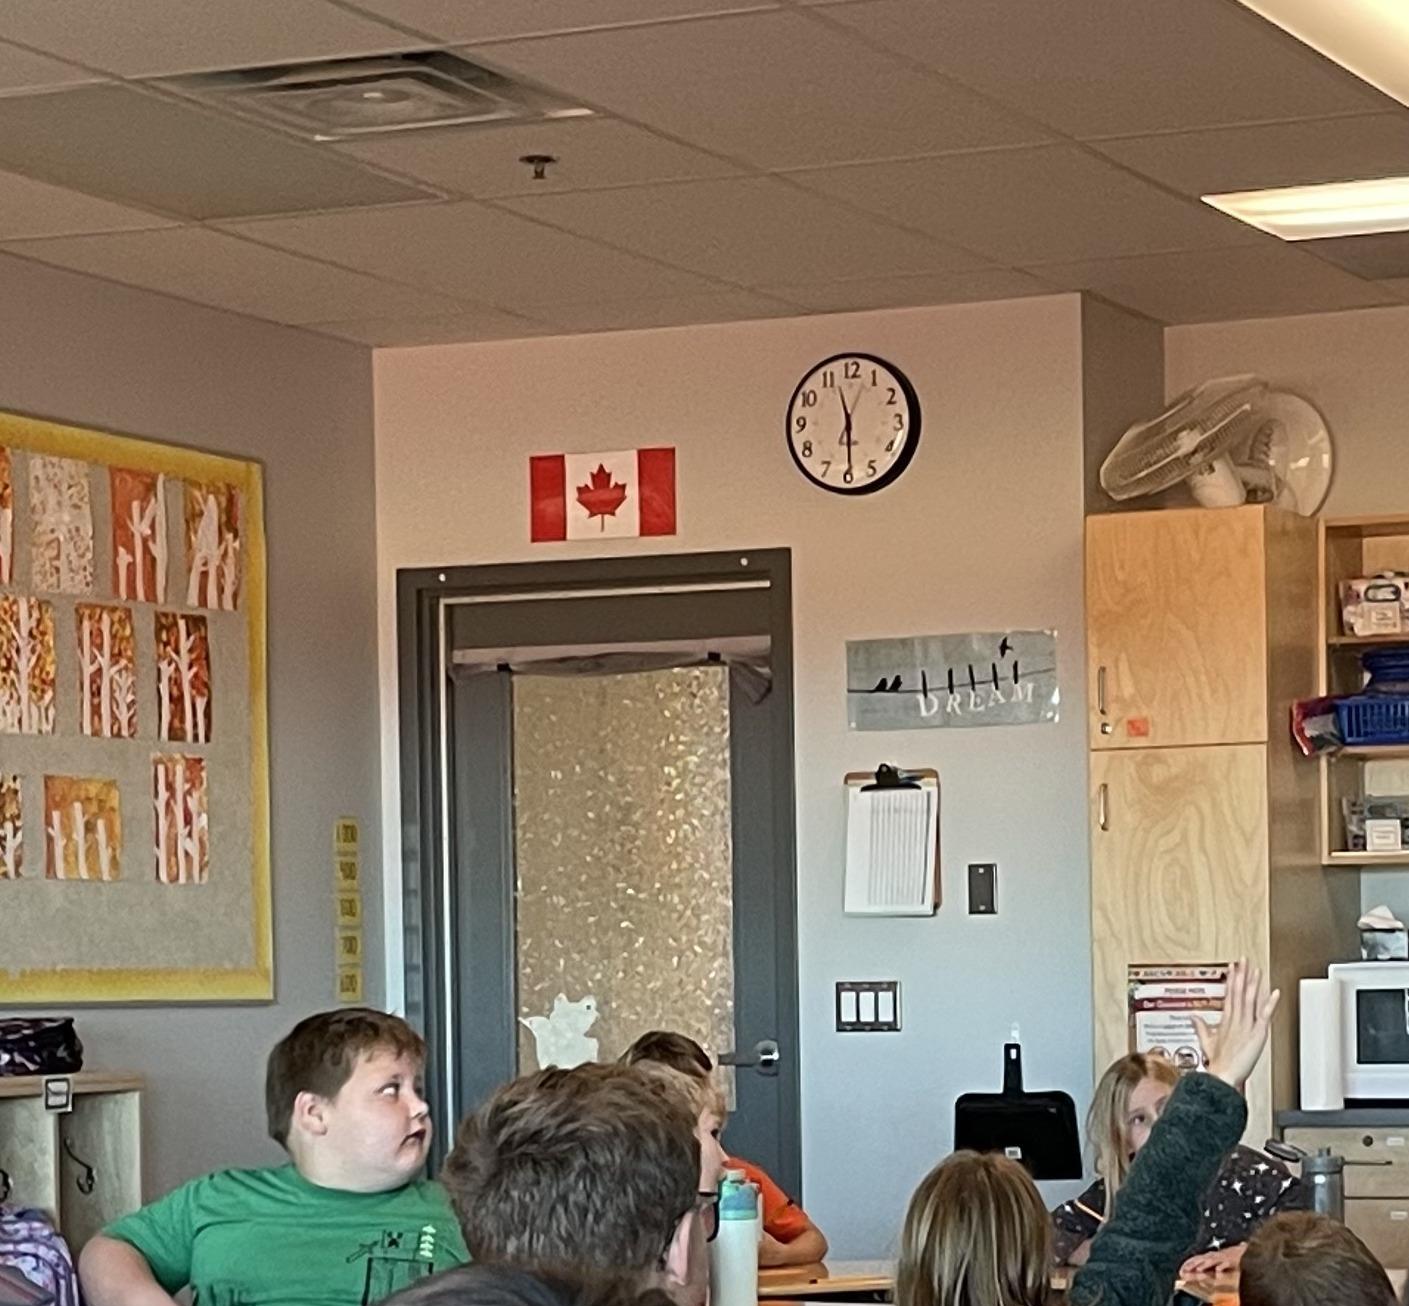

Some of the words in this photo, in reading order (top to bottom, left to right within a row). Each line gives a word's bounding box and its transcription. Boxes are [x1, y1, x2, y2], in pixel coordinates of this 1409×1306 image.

[822, 370, 834, 388] 11
[844, 361, 861, 379] 12
[870, 369, 877, 387] 1
[801, 389, 817, 407] 10
[886, 387, 897, 405] 2
[796, 416, 807, 433] 9
[893, 413, 904, 431] 3
[801, 440, 813, 458] 8
[821, 460, 832, 478] 7
[843, 466, 854, 484] 6
[866, 459, 877, 477] 5
[916, 682, 1034, 717] DREAM
